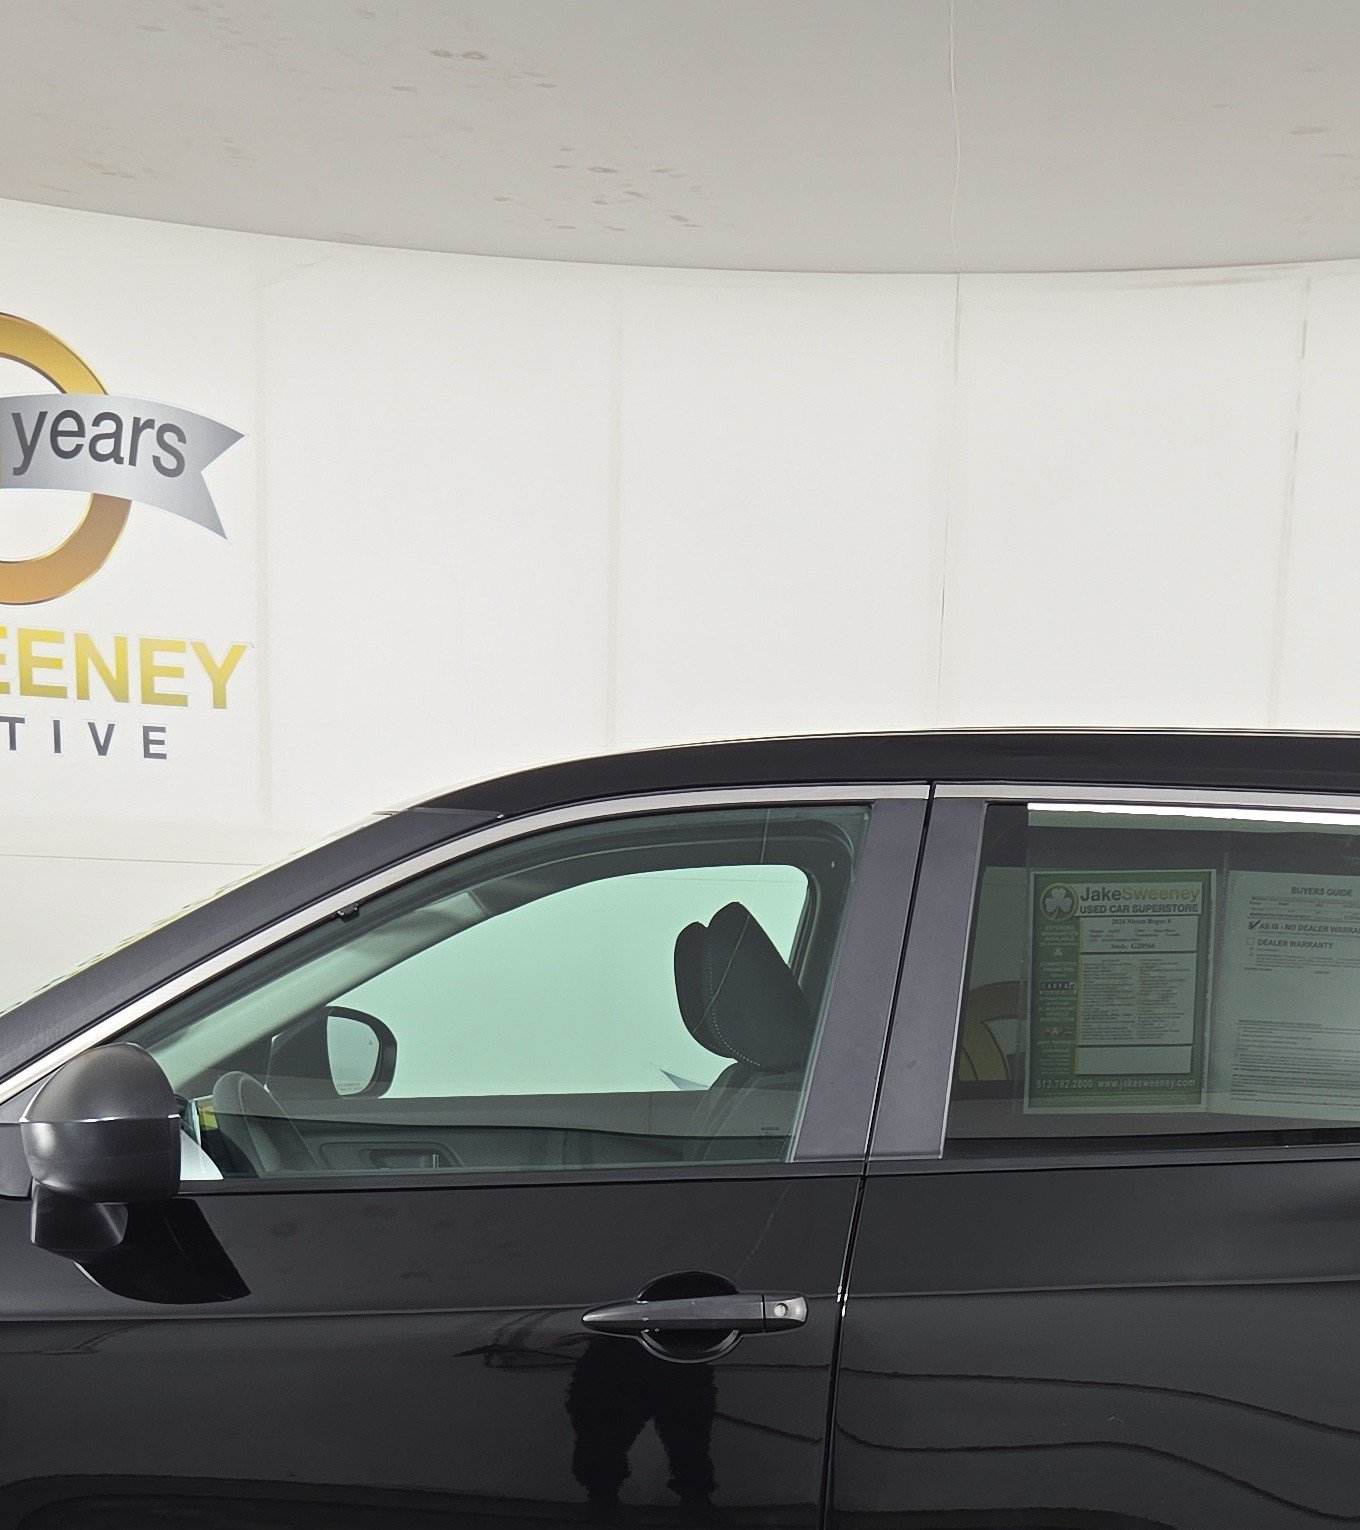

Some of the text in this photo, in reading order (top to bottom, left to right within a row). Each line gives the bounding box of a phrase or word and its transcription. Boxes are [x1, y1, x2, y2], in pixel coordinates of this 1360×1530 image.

[11, 405, 187, 478] years
[1291, 887, 1353, 897] BUYERS GUIDE
[1080, 903, 1199, 914] USED CAR SUPERSTORE
[1298, 924, 1329, 933] DEALER
[1258, 939, 1334, 949] DEALER WARRANTY
